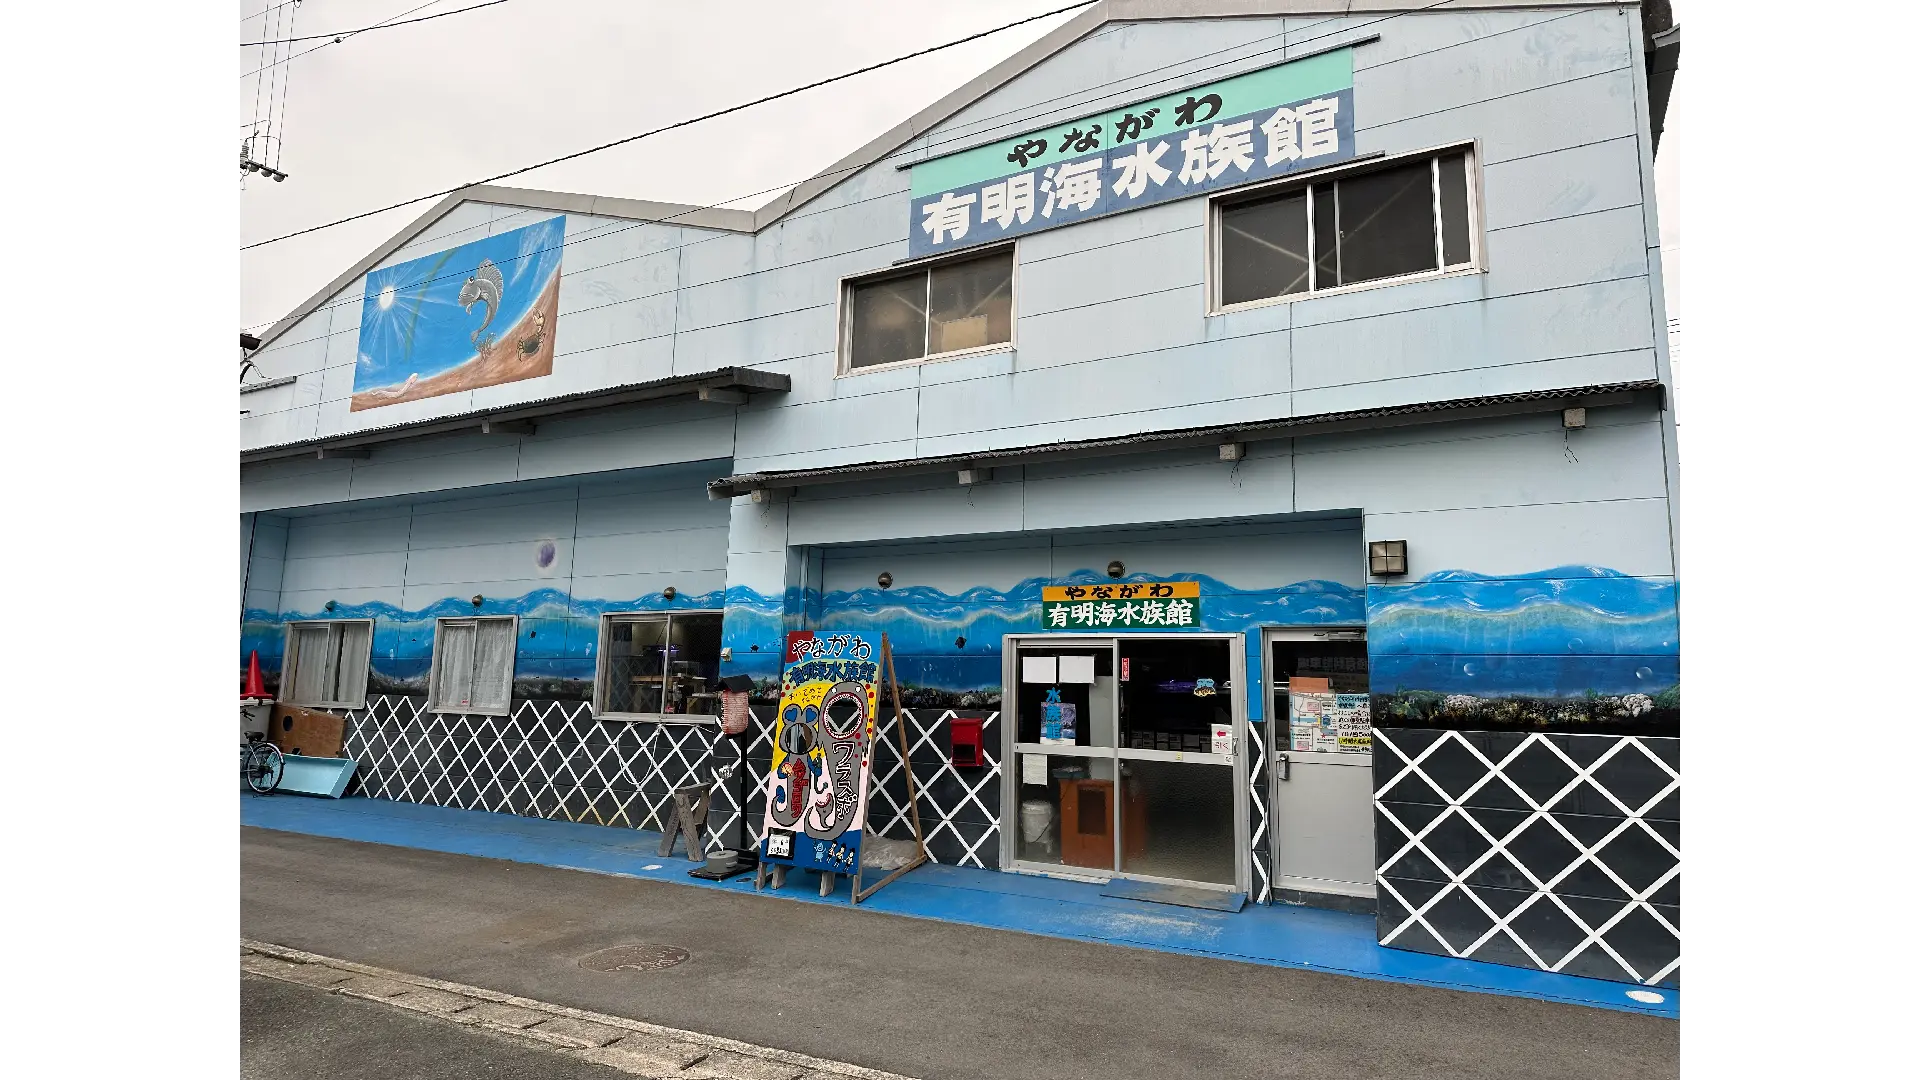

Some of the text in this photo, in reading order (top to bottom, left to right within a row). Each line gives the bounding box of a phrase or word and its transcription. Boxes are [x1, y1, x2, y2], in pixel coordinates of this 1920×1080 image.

[1007, 93, 1223, 168] やながわ
[922, 97, 1340, 245] 有明海水族館
[1048, 599, 1193, 627] 有明海水族館
[1065, 584, 1174, 600] やながわ
[792, 634, 872, 663] やながわ
[789, 661, 877, 687] 有明海水族館
[791, 758, 809, 818] ムツゴロウ
[832, 741, 858, 820] ワラスボ
